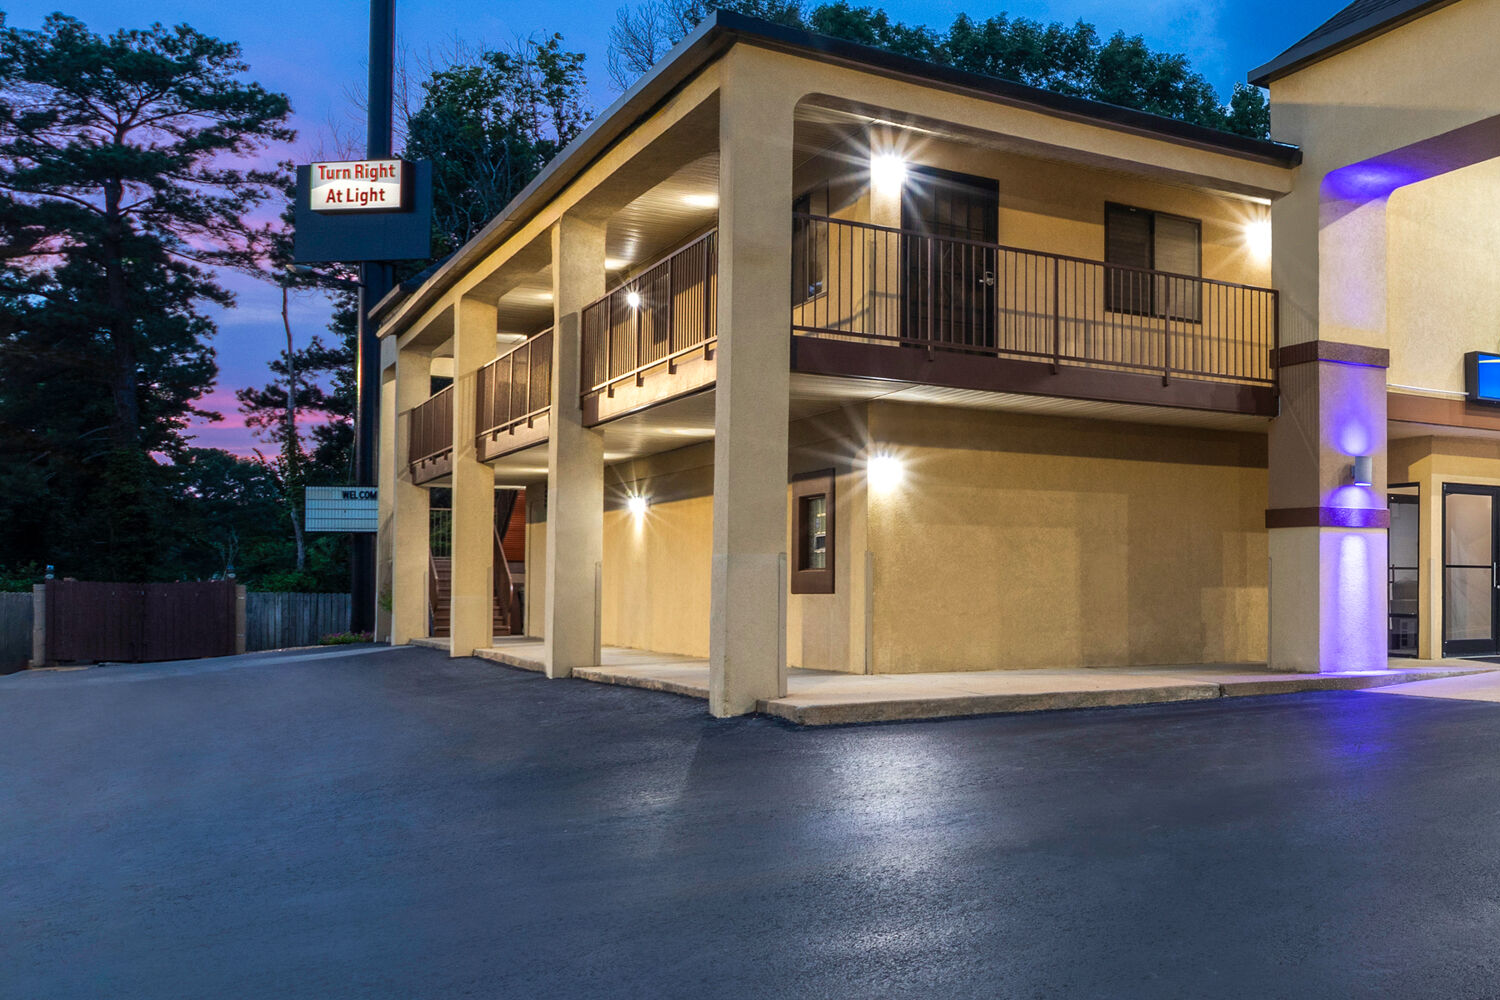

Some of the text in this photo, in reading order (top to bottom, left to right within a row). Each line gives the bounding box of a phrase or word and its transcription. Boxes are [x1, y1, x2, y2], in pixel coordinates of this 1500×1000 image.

[318, 163, 396, 182] Turn Right
[325, 187, 385, 206] At Light
